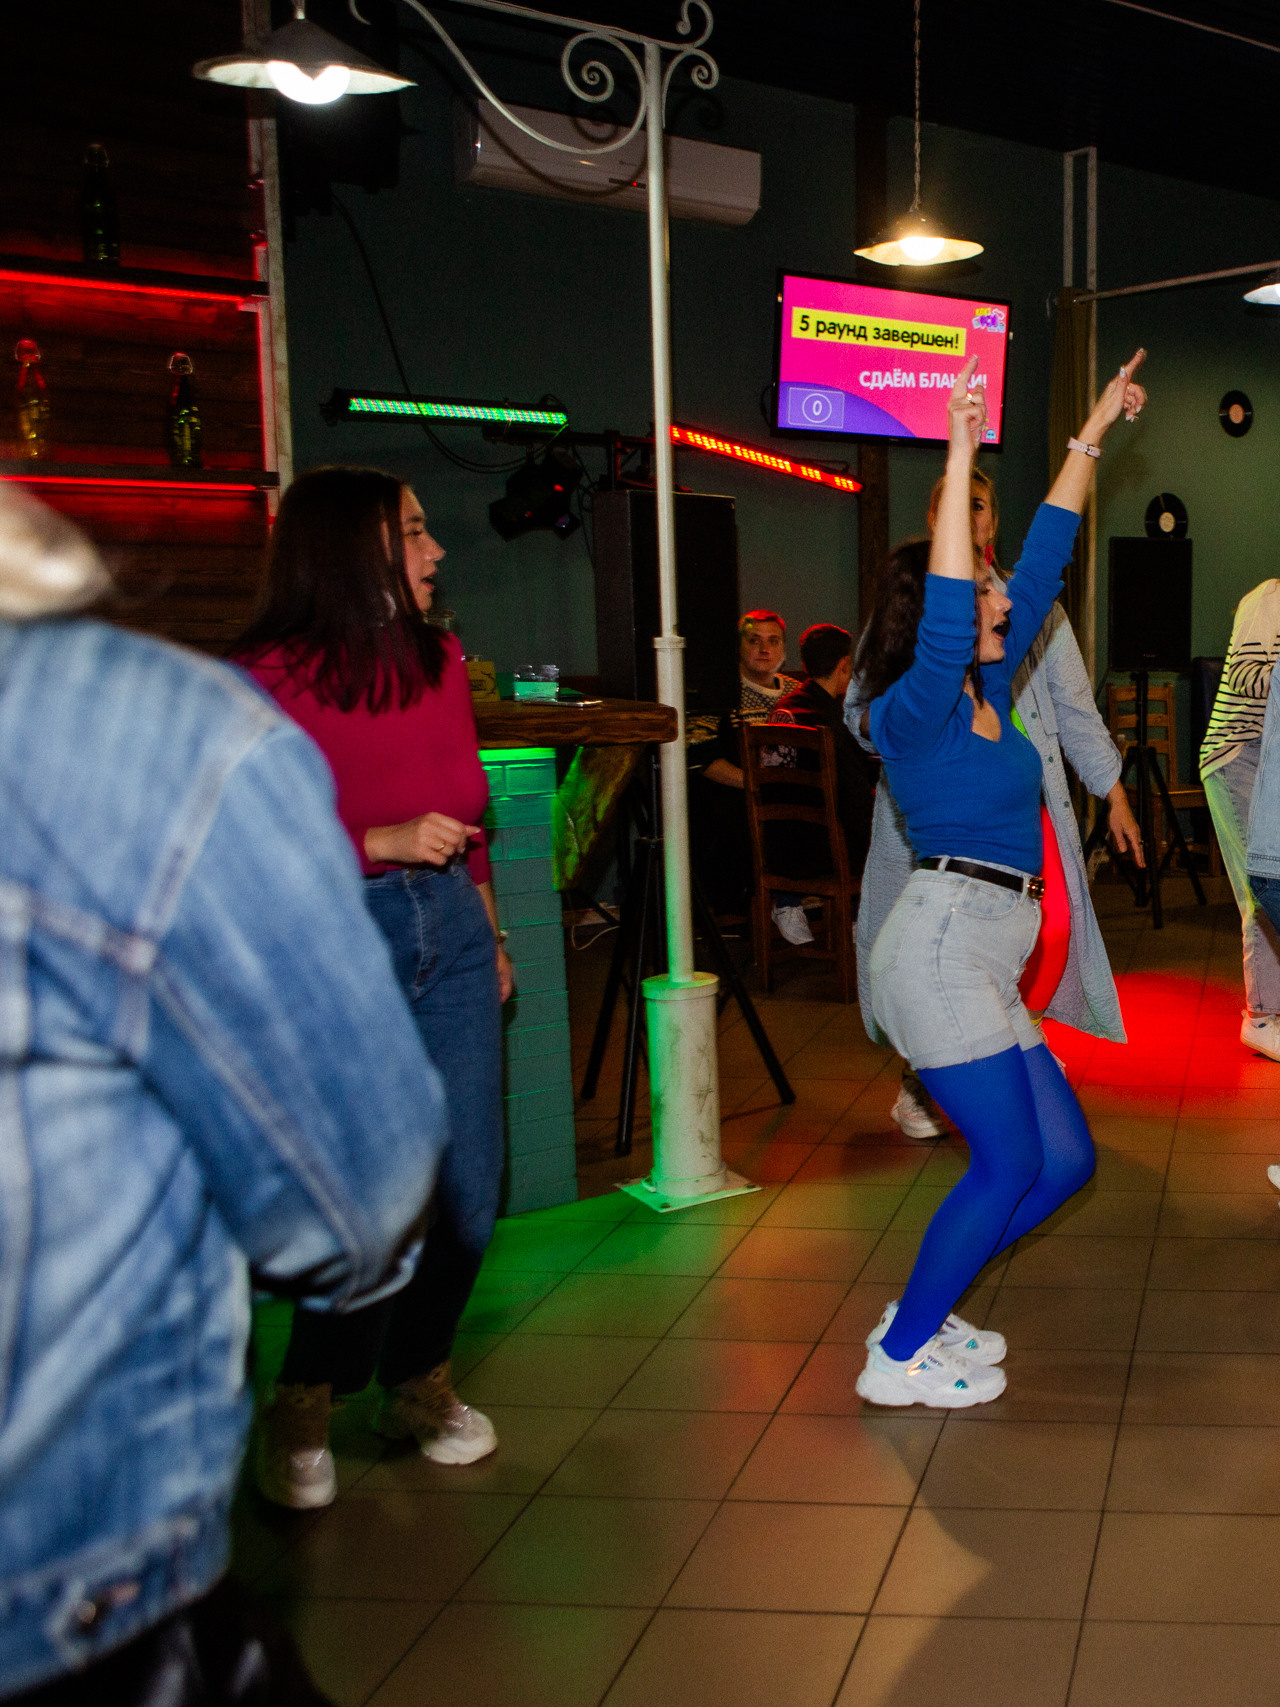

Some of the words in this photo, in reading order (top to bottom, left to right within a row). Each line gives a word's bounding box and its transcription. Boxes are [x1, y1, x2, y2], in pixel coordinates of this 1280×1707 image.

[799, 315, 810, 331] 5
[816, 320, 868, 341] раунд
[873, 327, 959, 349] завершен!
[859, 368, 916, 390] СДАЁМ
[919, 373, 987, 389] БЛАНИ!
